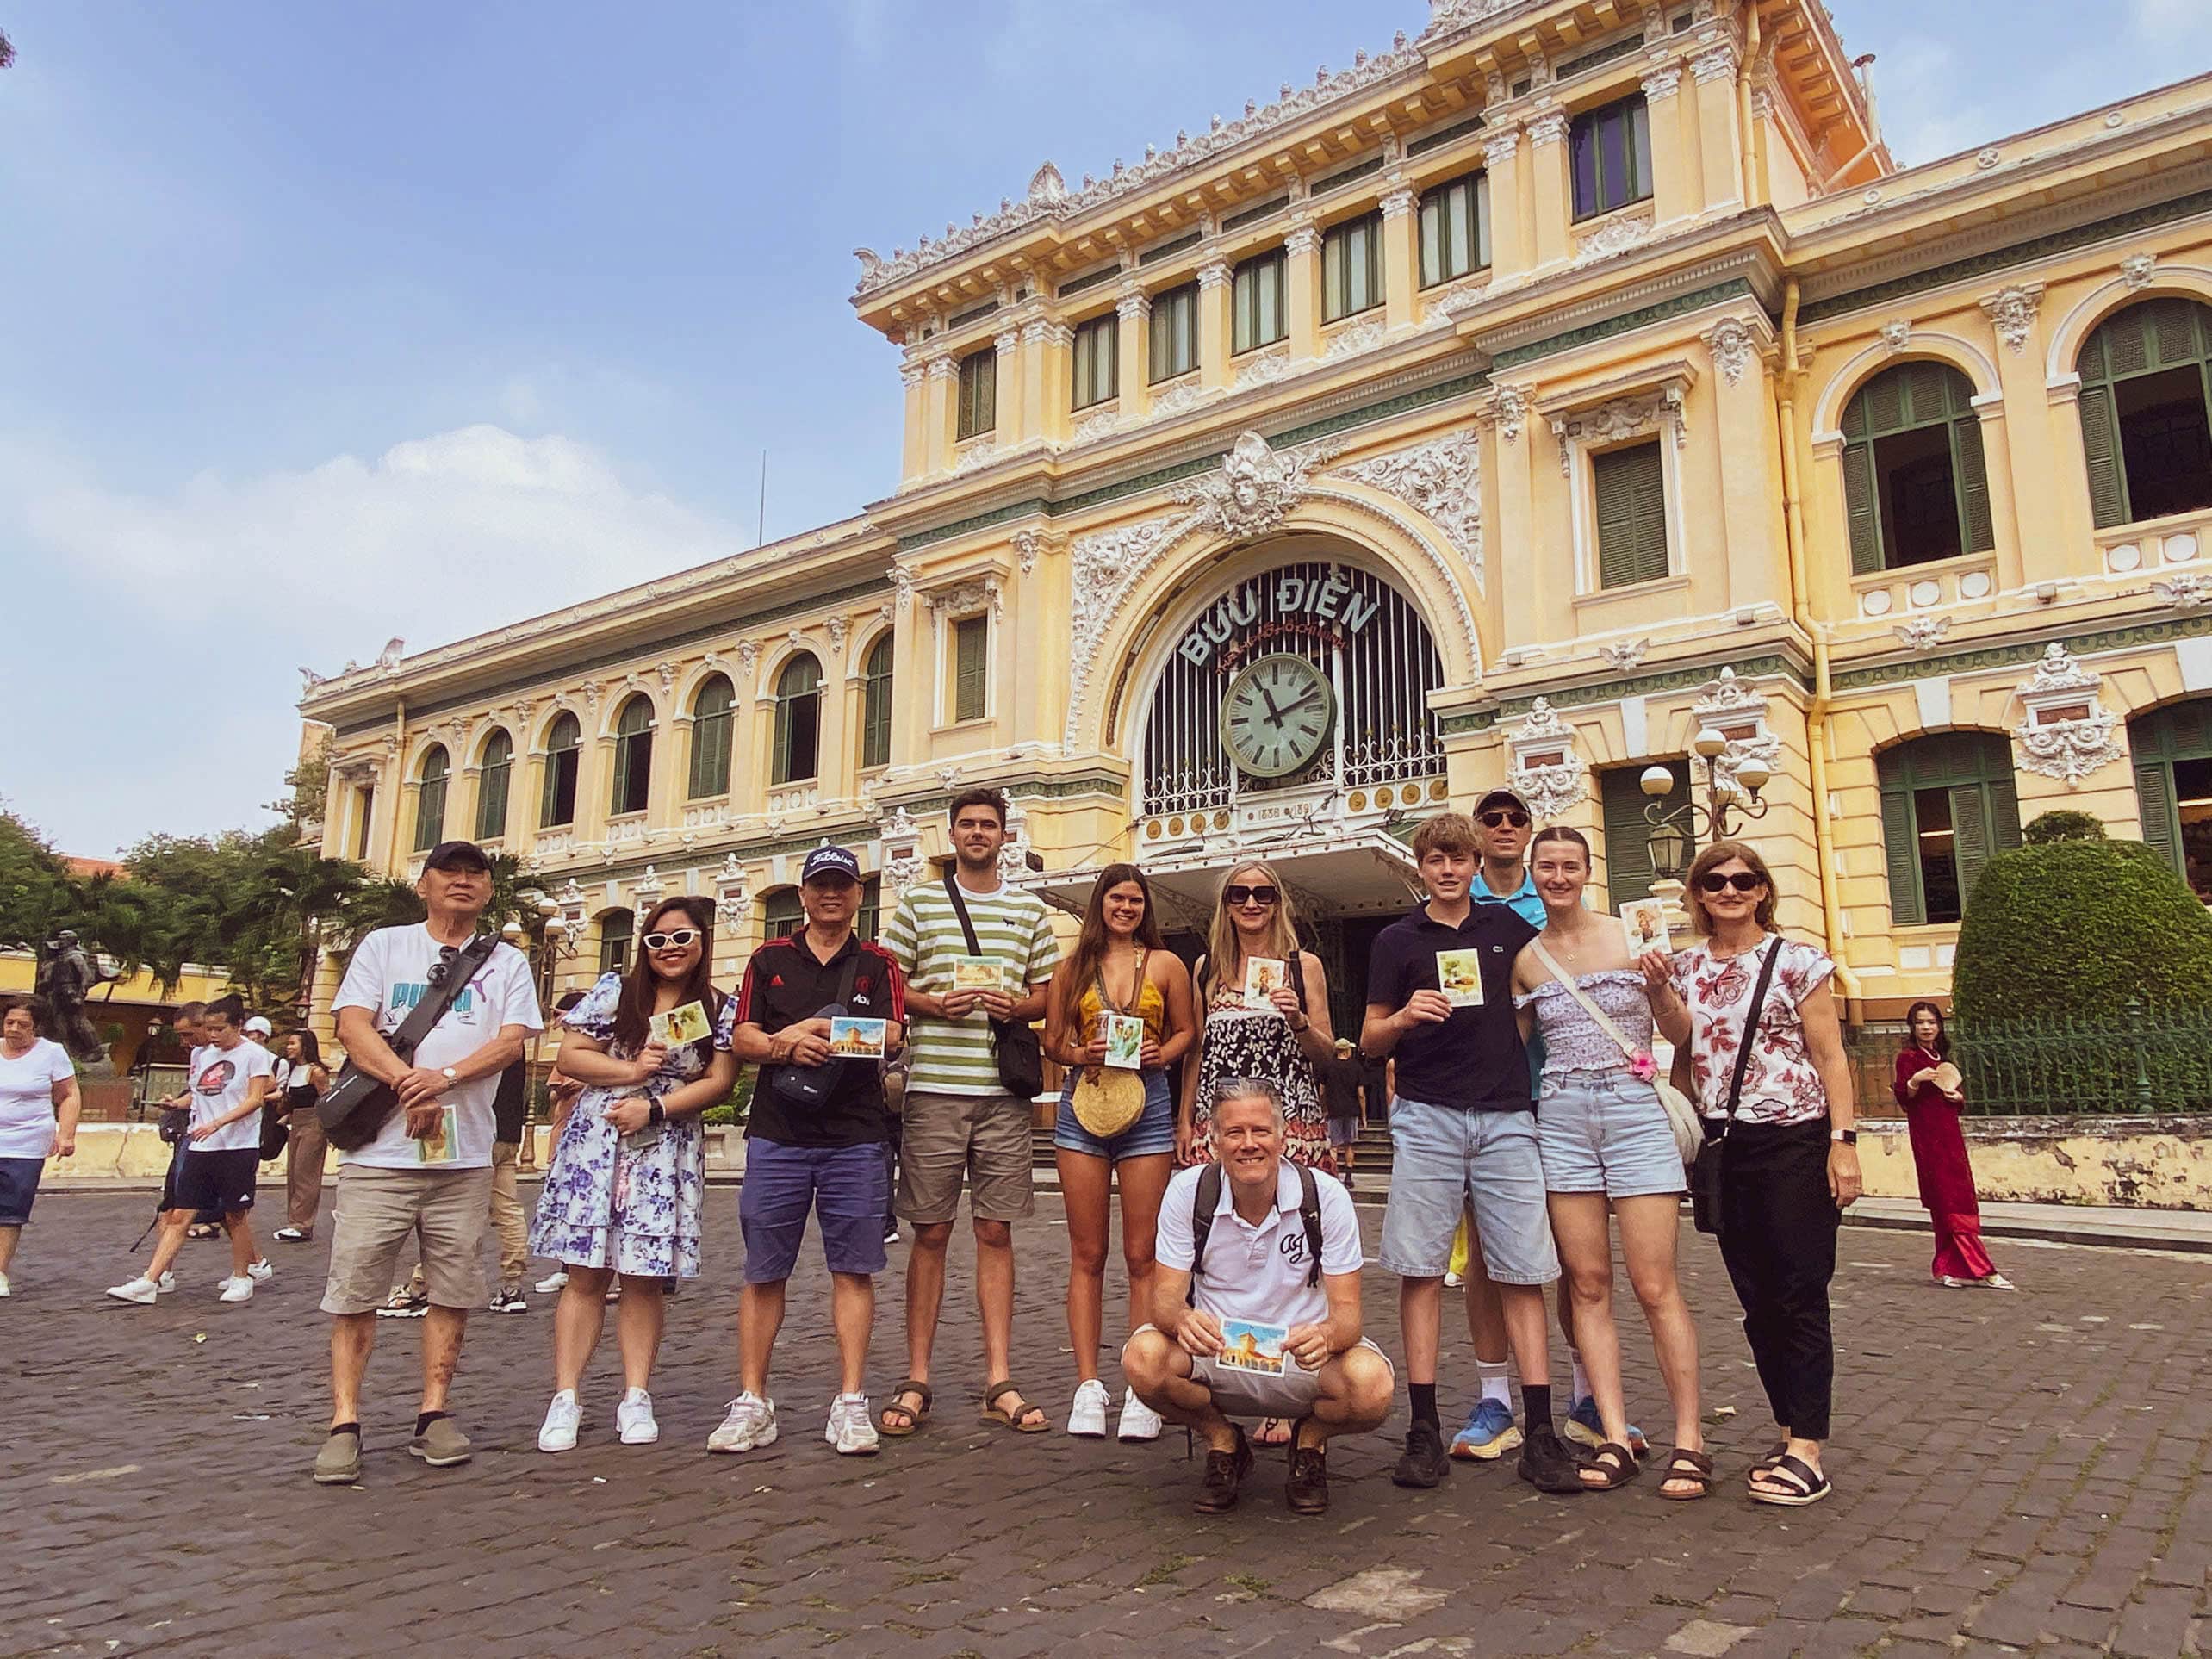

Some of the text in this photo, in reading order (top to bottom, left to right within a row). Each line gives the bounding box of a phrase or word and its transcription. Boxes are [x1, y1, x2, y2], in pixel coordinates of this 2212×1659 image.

[1178, 570, 1380, 667] BƯU ĐIỆN
[392, 984, 472, 1012] PUA
